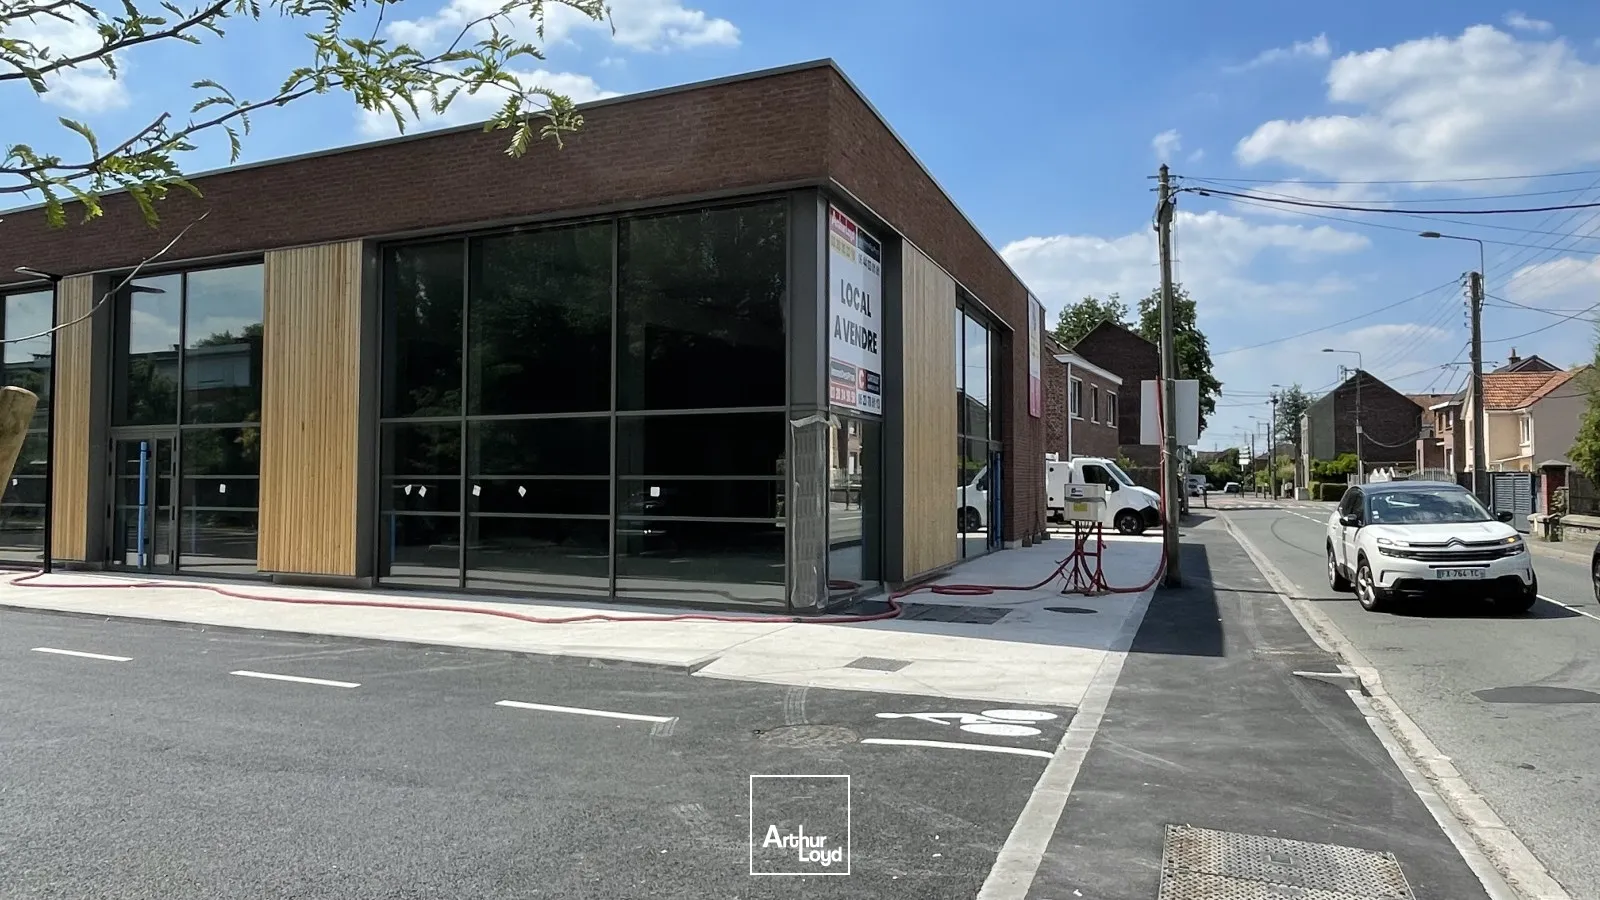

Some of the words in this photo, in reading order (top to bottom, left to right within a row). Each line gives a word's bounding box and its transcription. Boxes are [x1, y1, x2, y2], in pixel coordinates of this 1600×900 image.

[840, 278, 872, 318] LOCAL
[834, 315, 843, 341] A
[842, 319, 878, 355] VENDRE
